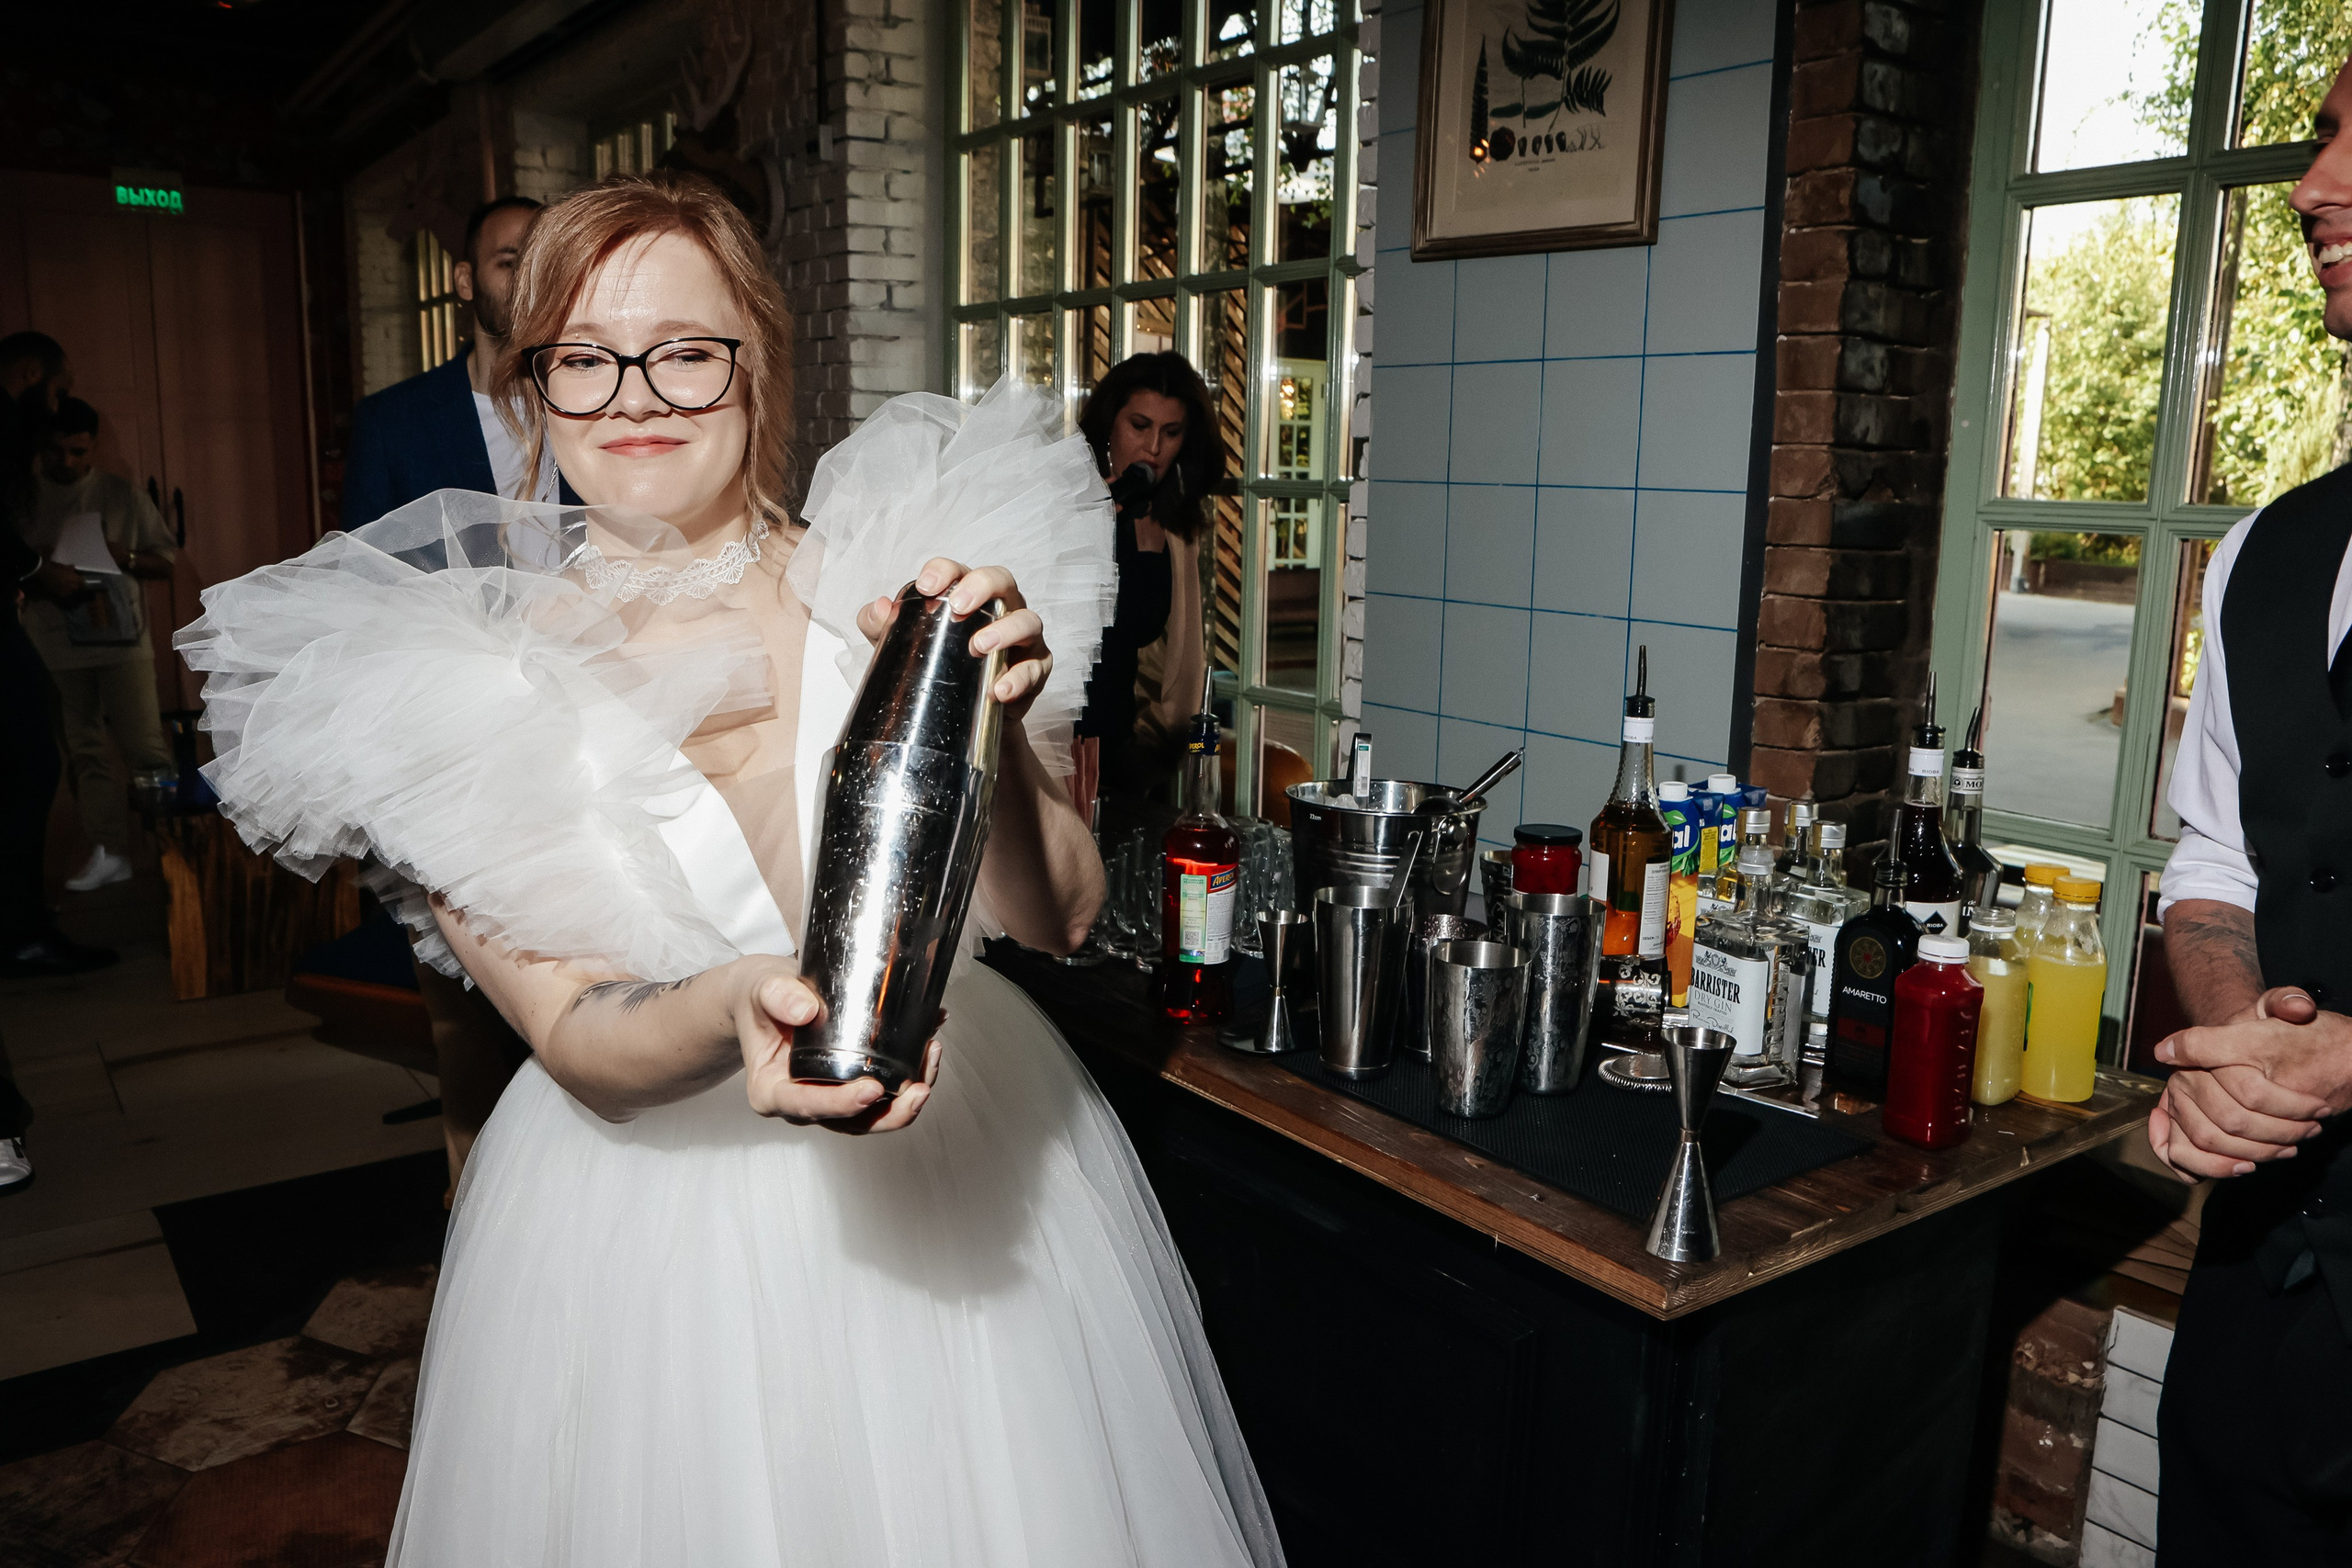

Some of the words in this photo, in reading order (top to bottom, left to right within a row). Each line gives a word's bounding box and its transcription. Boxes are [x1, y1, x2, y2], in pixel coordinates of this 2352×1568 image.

[116, 186, 183, 213] ВЫХОД
[1673, 825, 1690, 849] al
[1691, 966, 1740, 1004] BARRISTER
[1842, 986, 1887, 1005] AMARETTO
[1694, 989, 1713, 1006] DRY
[1713, 998, 1733, 1013] GIN
